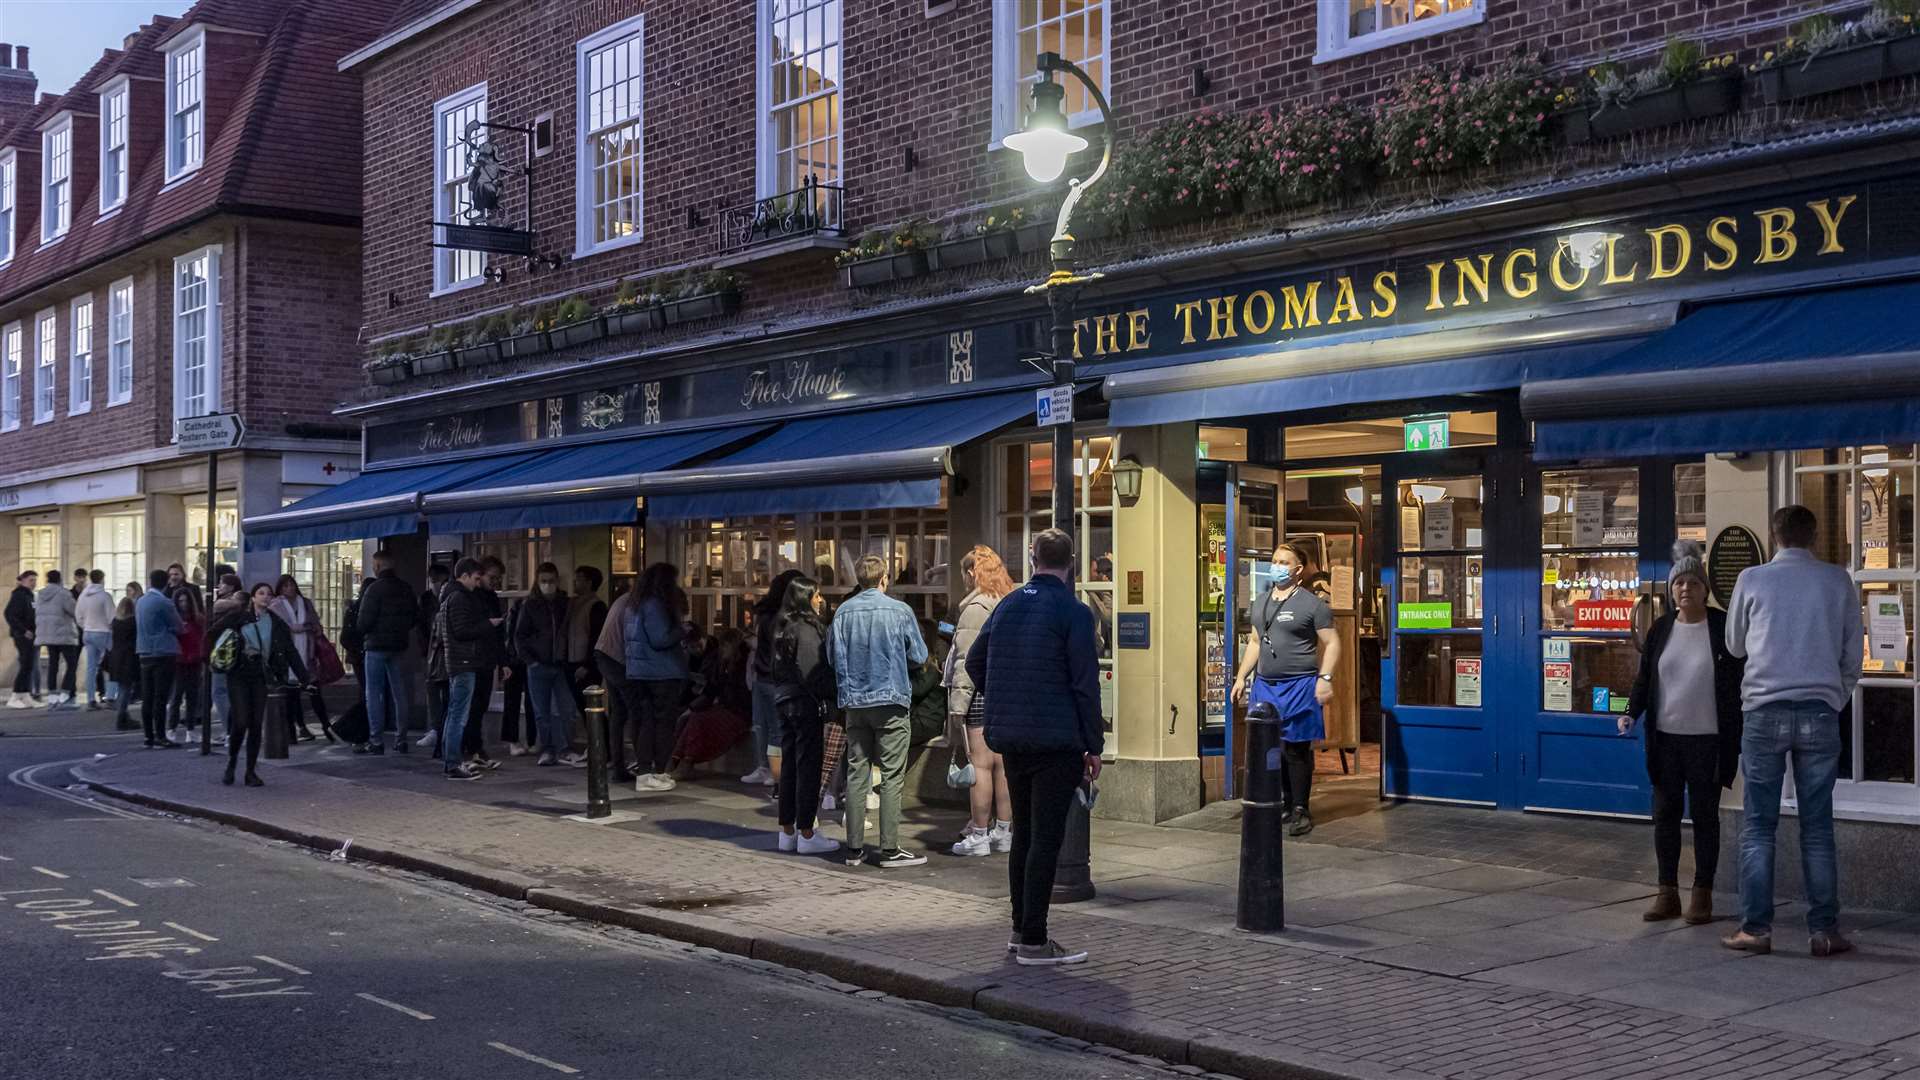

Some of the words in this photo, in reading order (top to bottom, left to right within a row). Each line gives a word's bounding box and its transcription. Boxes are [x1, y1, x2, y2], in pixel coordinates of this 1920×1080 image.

[1073, 308, 1150, 358] THE
[1175, 271, 1397, 345] THOMAS
[1424, 194, 1857, 311] INGOLDSBY
[741, 370, 780, 410] Free
[782, 361, 847, 403] House
[184, 420, 222, 431] Cathedral
[210, 430, 228, 438] Gate
[1400, 610, 1432, 619] ENTRANCE
[1433, 609, 1450, 619] ONLY
[1578, 607, 1601, 621] EXIT
[1603, 607, 1633, 621] ONLY
[160, 966, 313, 998] BAY
